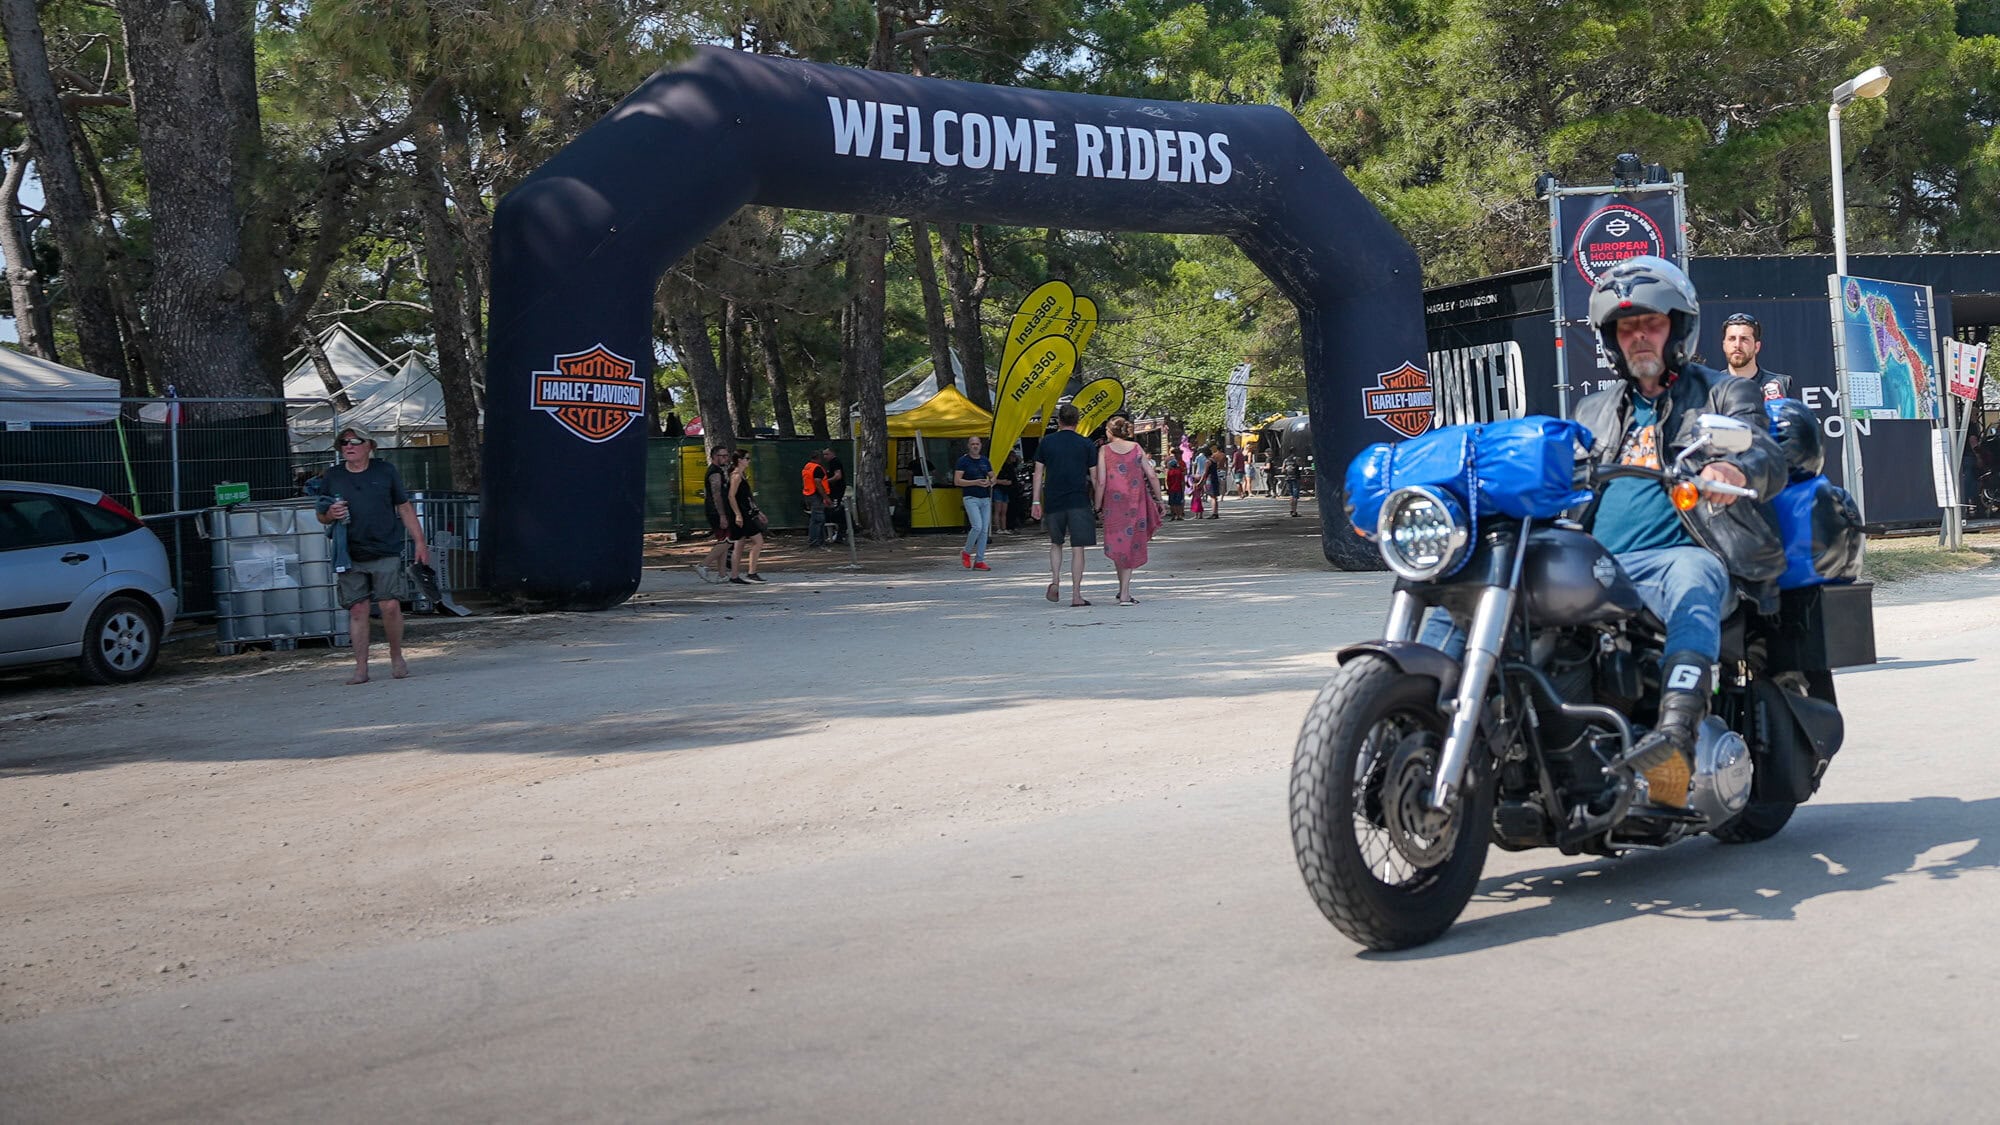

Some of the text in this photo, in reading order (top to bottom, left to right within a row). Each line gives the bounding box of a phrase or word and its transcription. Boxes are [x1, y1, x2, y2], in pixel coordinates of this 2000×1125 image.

[827, 96, 1233, 185] WELCOME RIDERS
[1589, 241, 1649, 252] EUROPEAN
[1015, 295, 1056, 346] Insta360
[570, 356, 625, 379] MOTOR
[1011, 350, 1057, 402] Insta360
[1390, 371, 1425, 389] MOTOR
[542, 381, 640, 406] HARLEY-DAVIDSON
[1427, 340, 1527, 430] UNITED
[567, 407, 622, 433] CYCLES
[1393, 411, 1429, 431] CYCLES
[1667, 664, 1702, 690] G
